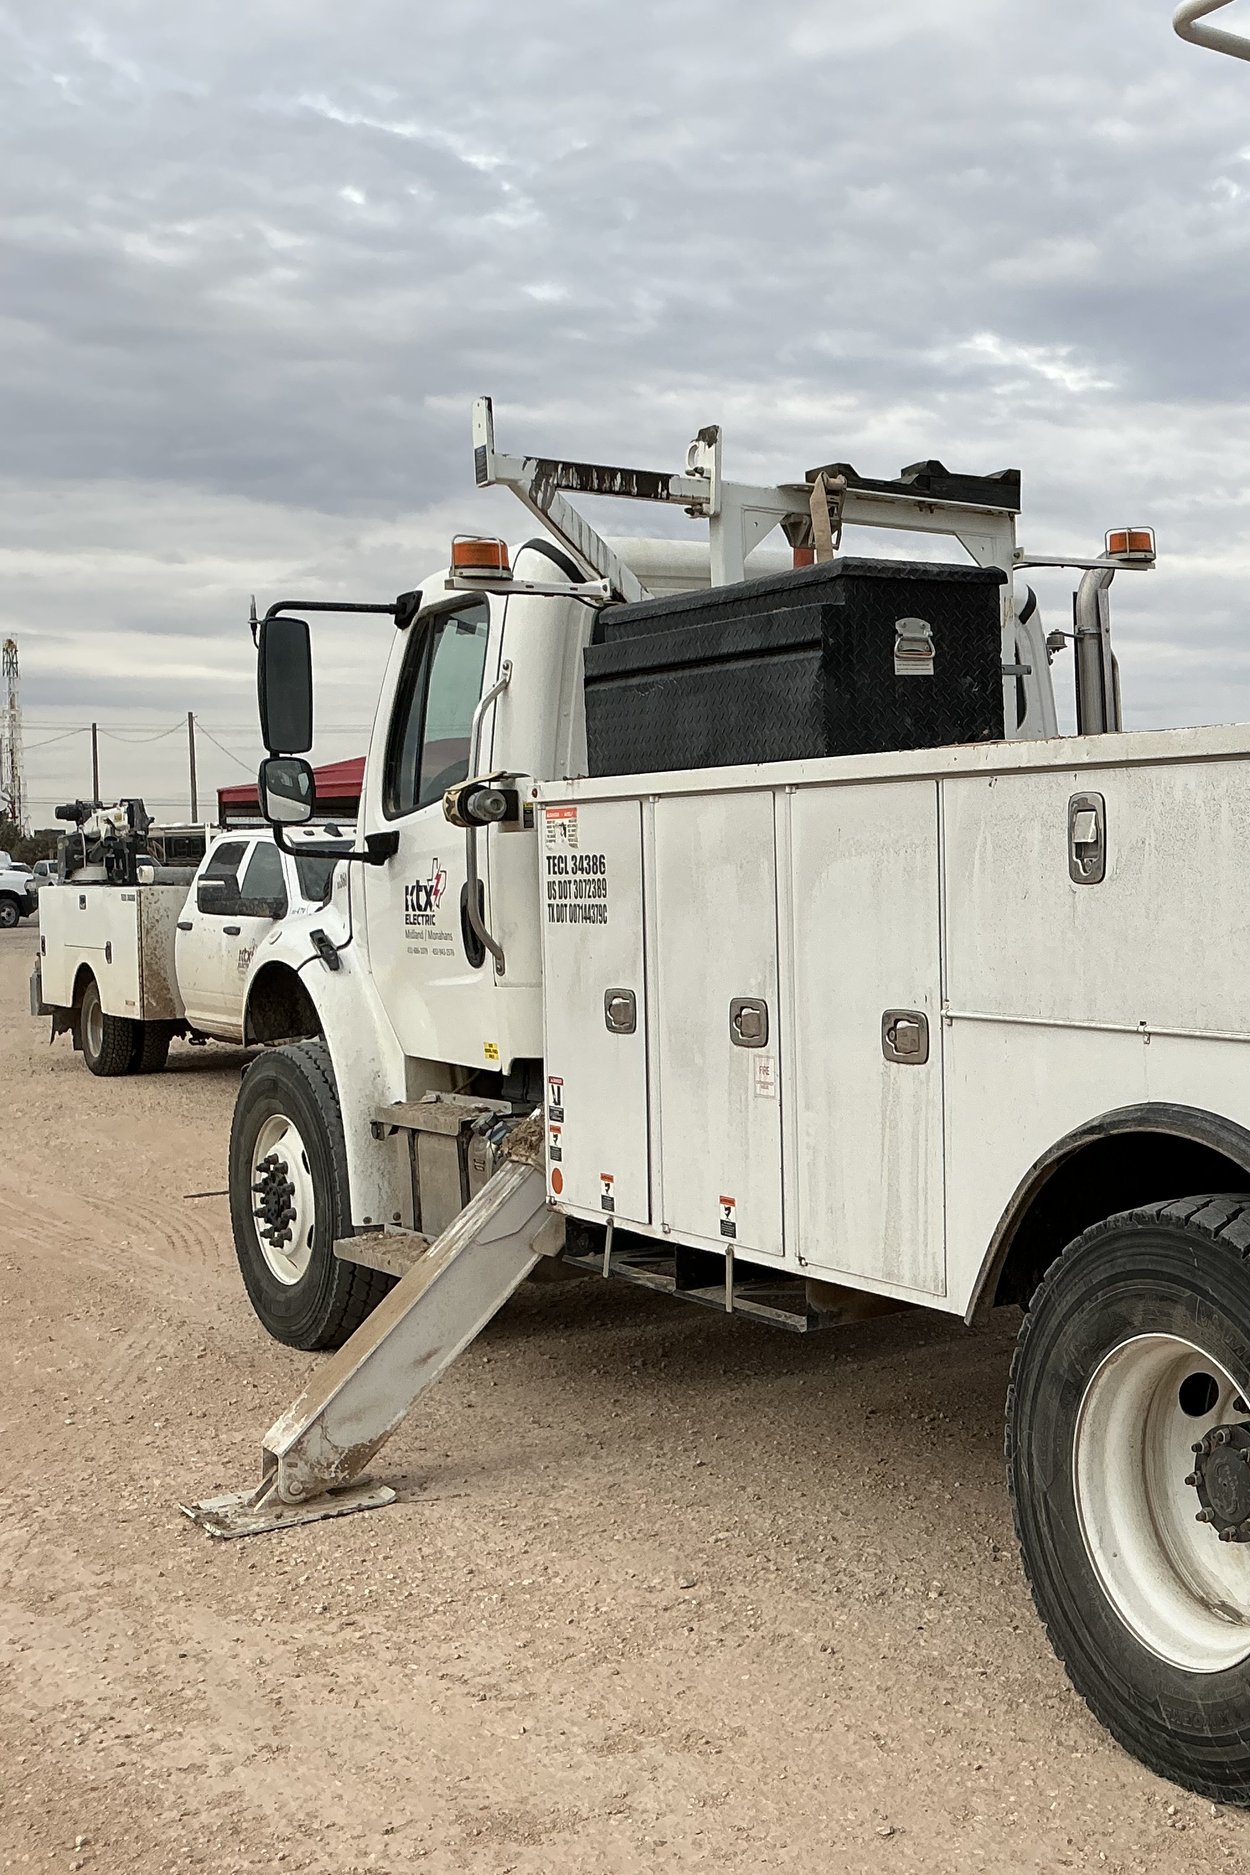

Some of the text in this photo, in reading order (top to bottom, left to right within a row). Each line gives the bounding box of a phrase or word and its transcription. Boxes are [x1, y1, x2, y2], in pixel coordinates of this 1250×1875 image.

[546, 854, 606, 875] TECL 34386
[547, 878, 606, 900] US DOT 3072389
[405, 914, 435, 926] ELECTRIC
[548, 904, 556, 923] TX
[556, 904, 568, 924] DOT
